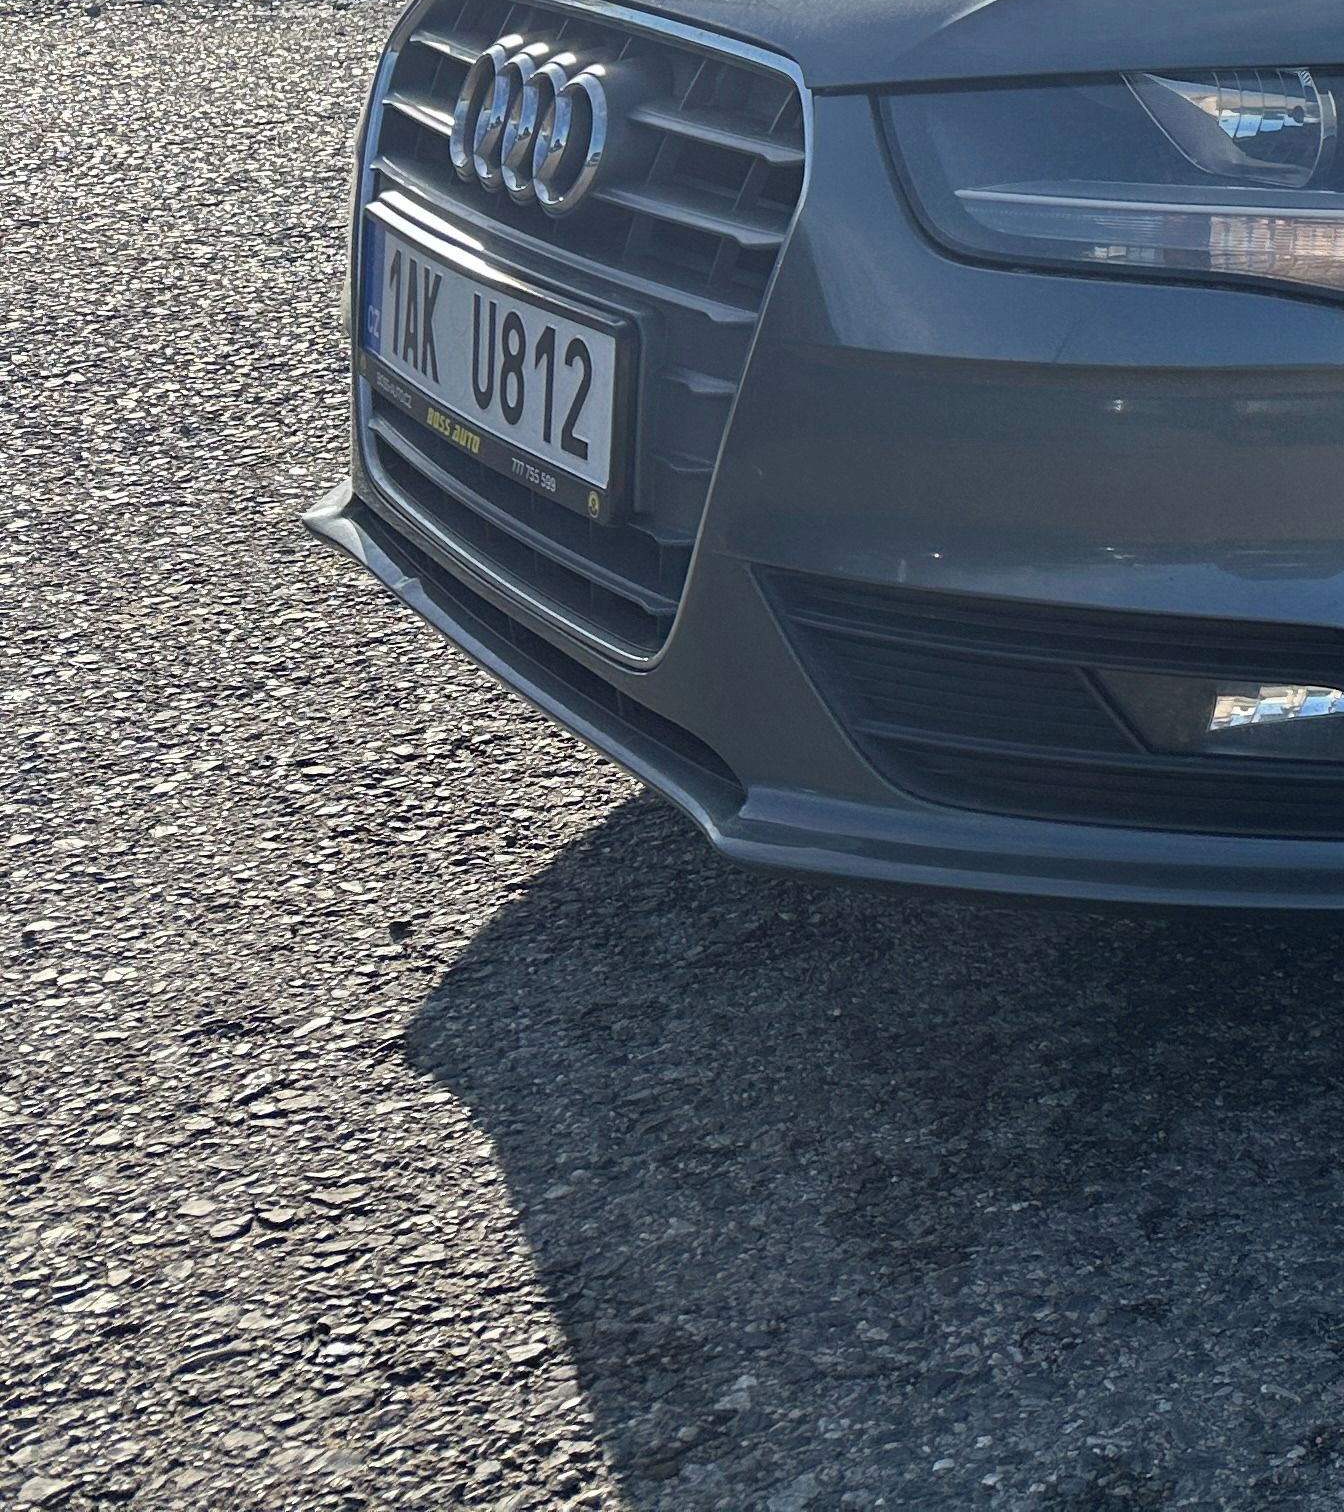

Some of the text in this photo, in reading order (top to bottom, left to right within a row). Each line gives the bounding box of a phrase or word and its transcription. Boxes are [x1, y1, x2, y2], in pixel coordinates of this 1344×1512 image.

[367, 304, 381, 338] CZ
[389, 249, 593, 461] 1AK U812
[426, 407, 451, 436] BOSS
[526, 464, 540, 485] 755
